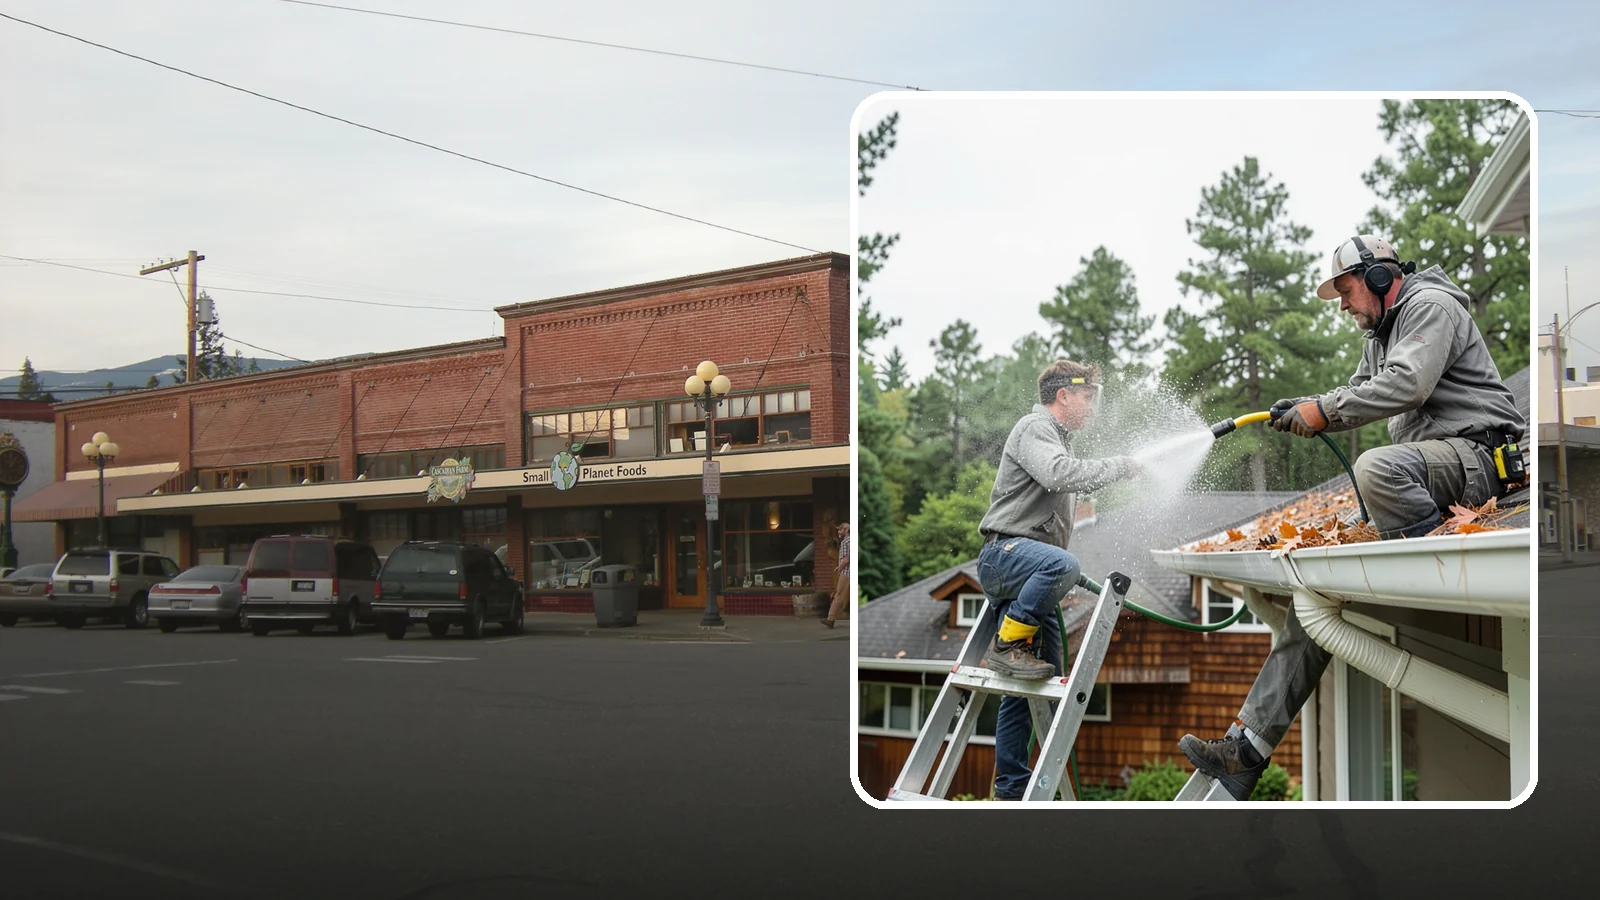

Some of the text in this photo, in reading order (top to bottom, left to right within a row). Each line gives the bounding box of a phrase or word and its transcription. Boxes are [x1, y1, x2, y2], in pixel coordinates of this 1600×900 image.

[523, 464, 647, 482] Small Planet Foods
